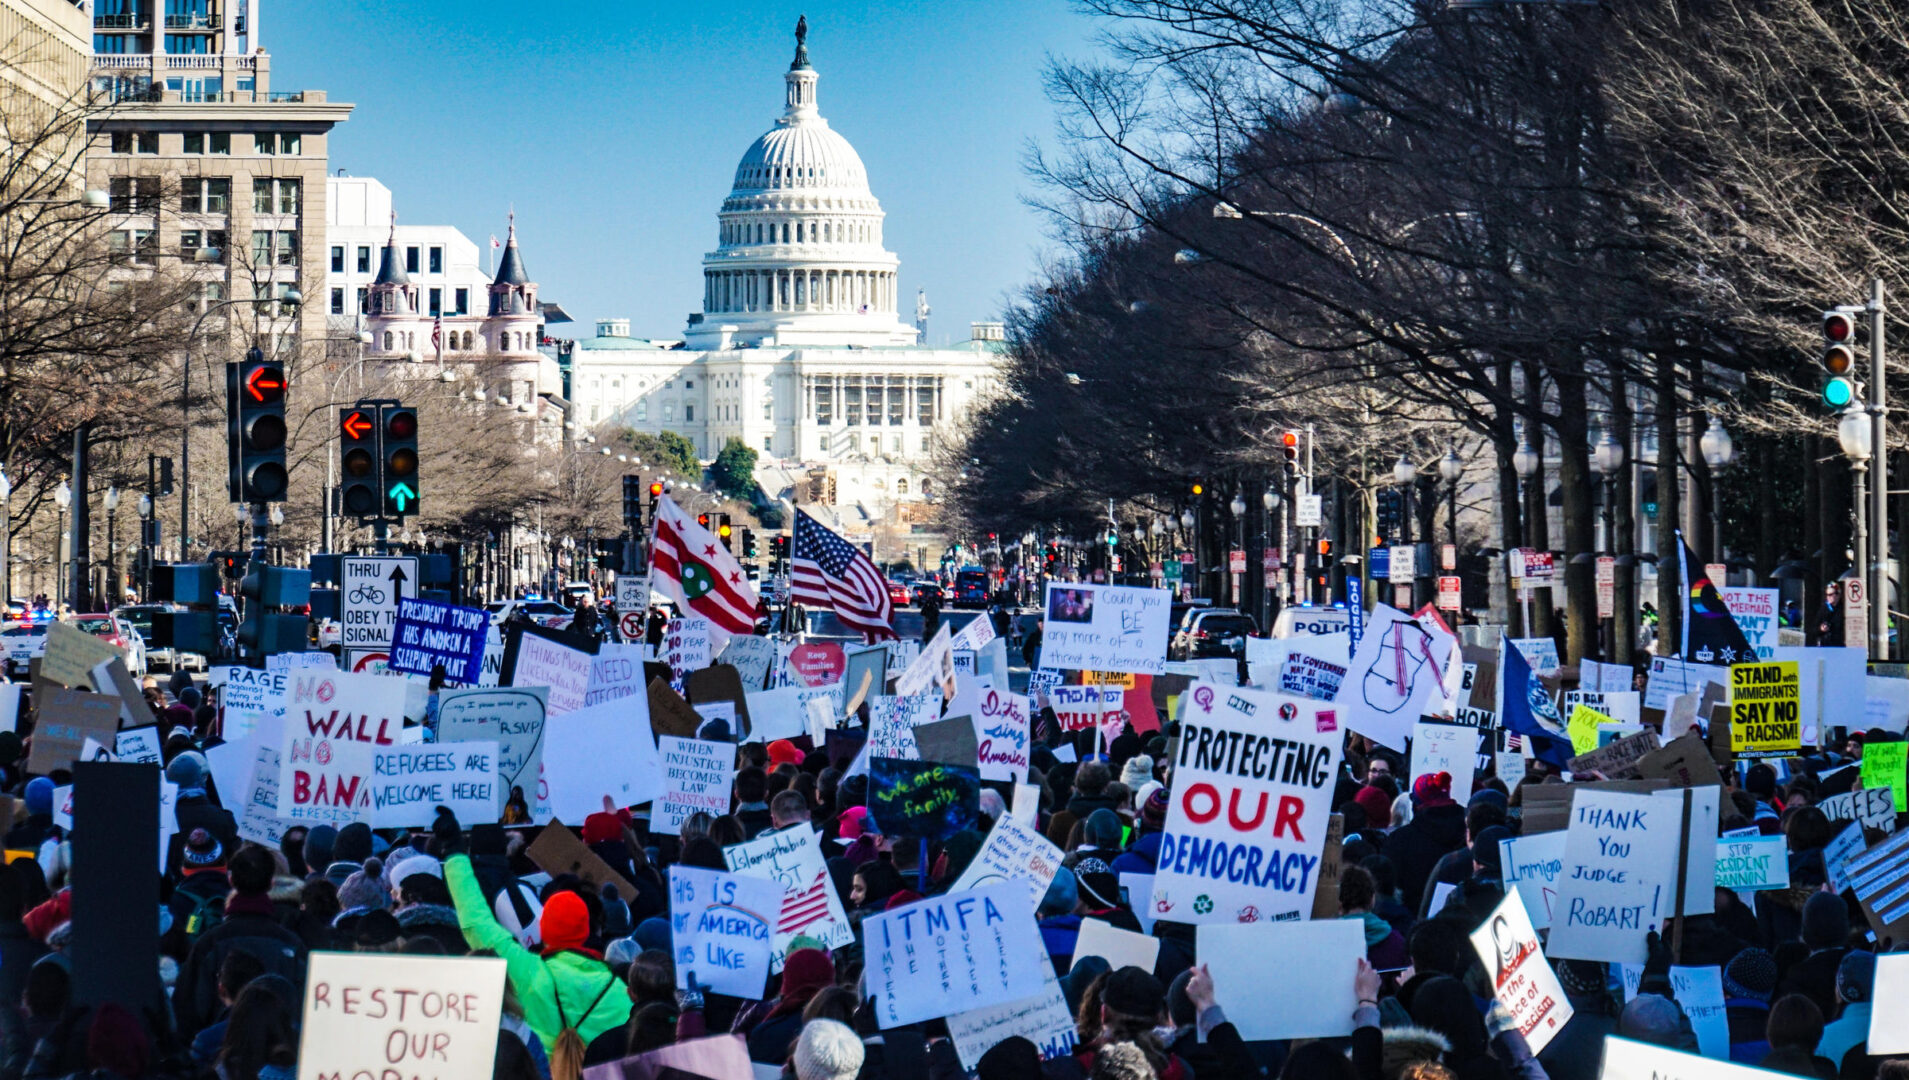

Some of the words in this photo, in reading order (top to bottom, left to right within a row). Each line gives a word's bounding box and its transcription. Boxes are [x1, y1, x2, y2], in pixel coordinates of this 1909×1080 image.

[348, 562, 381, 578] THRU
[1102, 591, 1133, 606] Could
[1140, 596, 1161, 609] you
[1730, 603, 1773, 615] MERMAID
[1747, 593, 1771, 604] THE
[346, 610, 381, 625] OBEY
[384, 611, 398, 625] TH
[401, 601, 447, 624] PRESIDENT
[452, 608, 484, 631] TRUMP
[1121, 609, 1145, 630] BE
[346, 627, 391, 643] SIGNAL
[667, 620, 682, 634] NO
[403, 625, 420, 645] HAS
[462, 635, 471, 655] A
[668, 636, 682, 650] NO
[1048, 631, 1069, 649] any
[1073, 635, 1103, 645] more
[1106, 633, 1124, 648] of
[1135, 639, 1144, 648] a
[395, 648, 434, 672] SLEEPING
[523, 636, 561, 668] THINGS
[561, 651, 590, 678] MORE
[669, 653, 682, 665] NO
[1091, 652, 1102, 665] to
[229, 667, 287, 692] RAGE
[593, 658, 633, 685] NEED
[1733, 665, 1782, 685] STAND
[1782, 673, 1798, 683] with
[228, 683, 264, 695] against
[295, 675, 337, 705] NO
[1567, 693, 1580, 703] NO
[1734, 684, 1798, 700] IMMIGRANTS!
[1734, 702, 1771, 725] SAY
[1773, 701, 1798, 723] NO
[305, 709, 395, 747] WALL
[500, 720, 541, 736] RSVP
[1735, 734, 1744, 743] to
[1746, 722, 1798, 743] RACISM!
[290, 738, 334, 765] NO
[677, 741, 714, 755] WHEN
[375, 752, 456, 777] REFUGEES
[464, 753, 491, 774] ARE
[665, 752, 726, 772] INJUSTICE
[668, 768, 722, 785] BECOMES
[292, 769, 362, 809] BAN
[372, 784, 442, 810] WELCOME
[451, 782, 492, 802] HERE!
[681, 782, 708, 793] LAW
[289, 806, 361, 822] #RESIST
[1182, 783, 1305, 843] OUR
[1576, 804, 1647, 836] THANK
[726, 834, 808, 873] Islamophobia
[1728, 843, 1753, 858] STOP
[1158, 832, 1318, 895] DEMOCRACY
[1714, 855, 1772, 872] RESIDENT
[1570, 865, 1628, 884] JUDGE
[1714, 870, 1768, 888] BANNON
[697, 911, 770, 943] AMERICA
[706, 942, 746, 970] LIKE
[1507, 974, 1526, 997] the
[314, 982, 478, 1023] RESTORE
[1509, 997, 1529, 1019] ace
[1527, 980, 1540, 1001] of
[1518, 995, 1557, 1038] ascism
[385, 1029, 452, 1065] OUR
